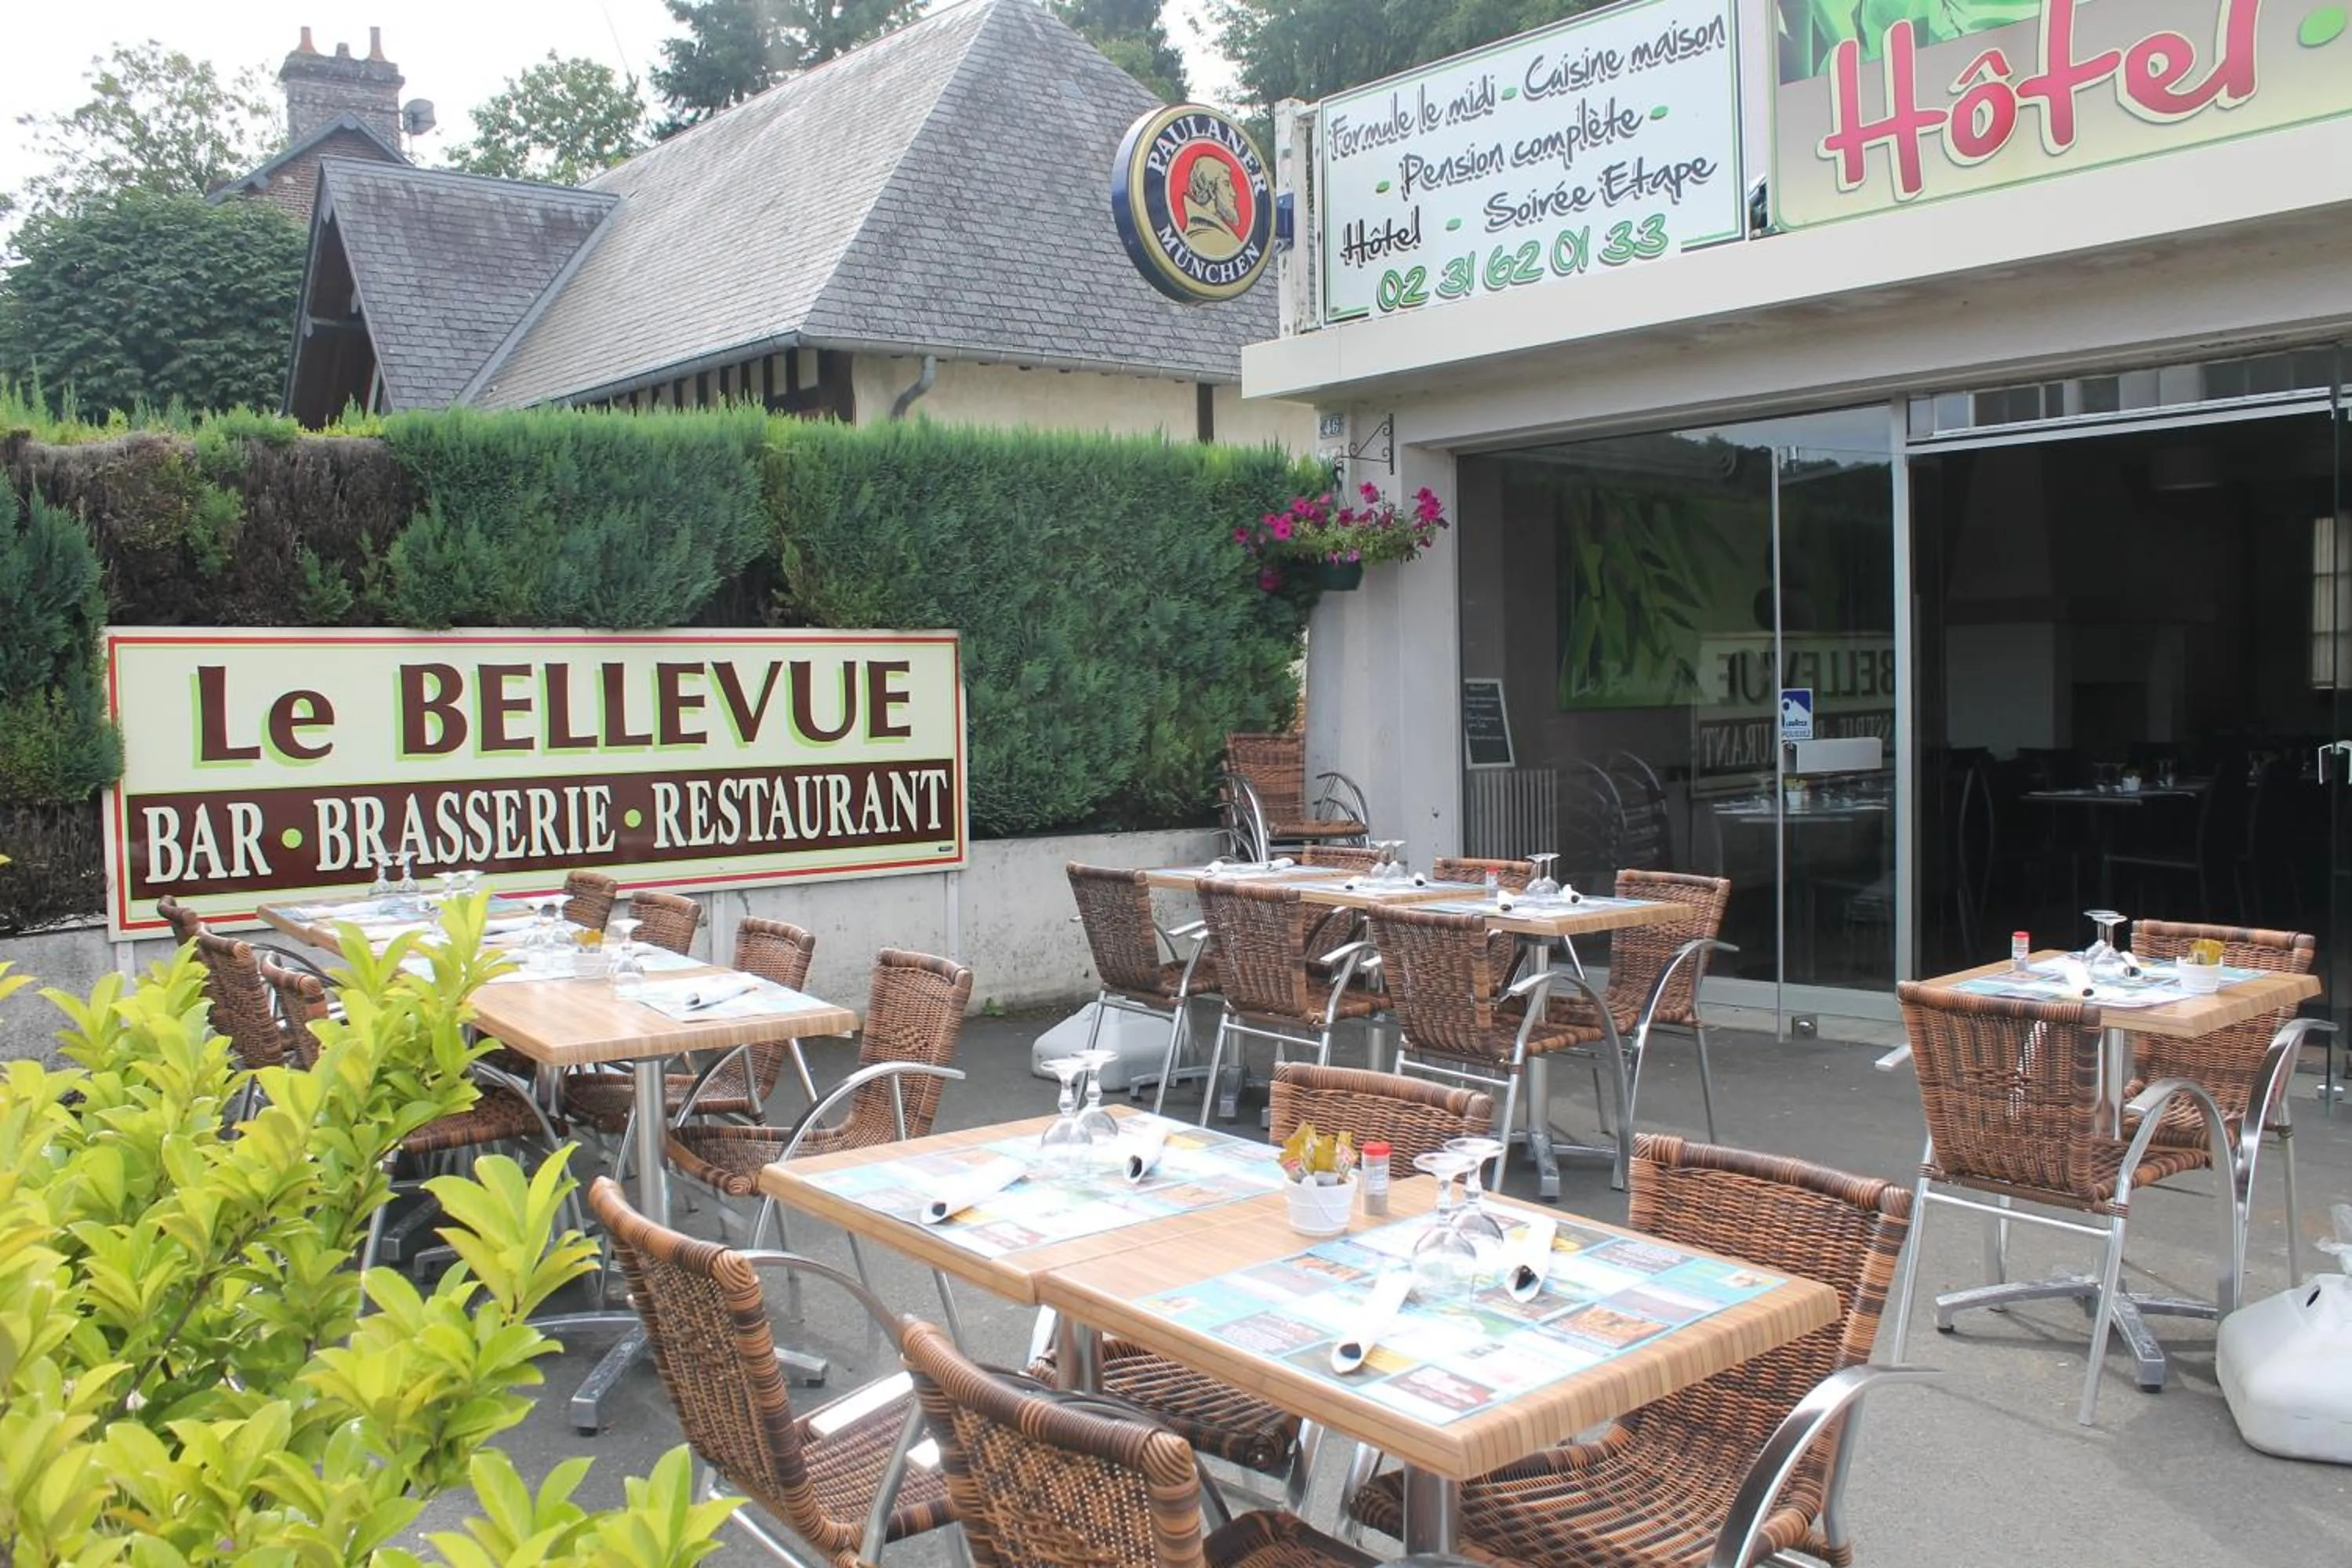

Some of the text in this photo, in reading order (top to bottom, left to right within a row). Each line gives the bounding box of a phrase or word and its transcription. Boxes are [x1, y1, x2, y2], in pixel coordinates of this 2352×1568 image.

[1330, 14, 1725, 158] Formule le midi Cuisine maison
[1820, 0, 2261, 198] Hôtel
[1147, 116, 1267, 196] PAULANER
[1400, 97, 1643, 201] Pension complète
[1341, 157, 1717, 267] Hôtel Soirée Etape
[1377, 213, 1669, 311] 02 31 62 01 33
[192, 661, 911, 768] Le BELLEVUE
[143, 770, 947, 884] BAR BRASSERIE RESTAURANT
